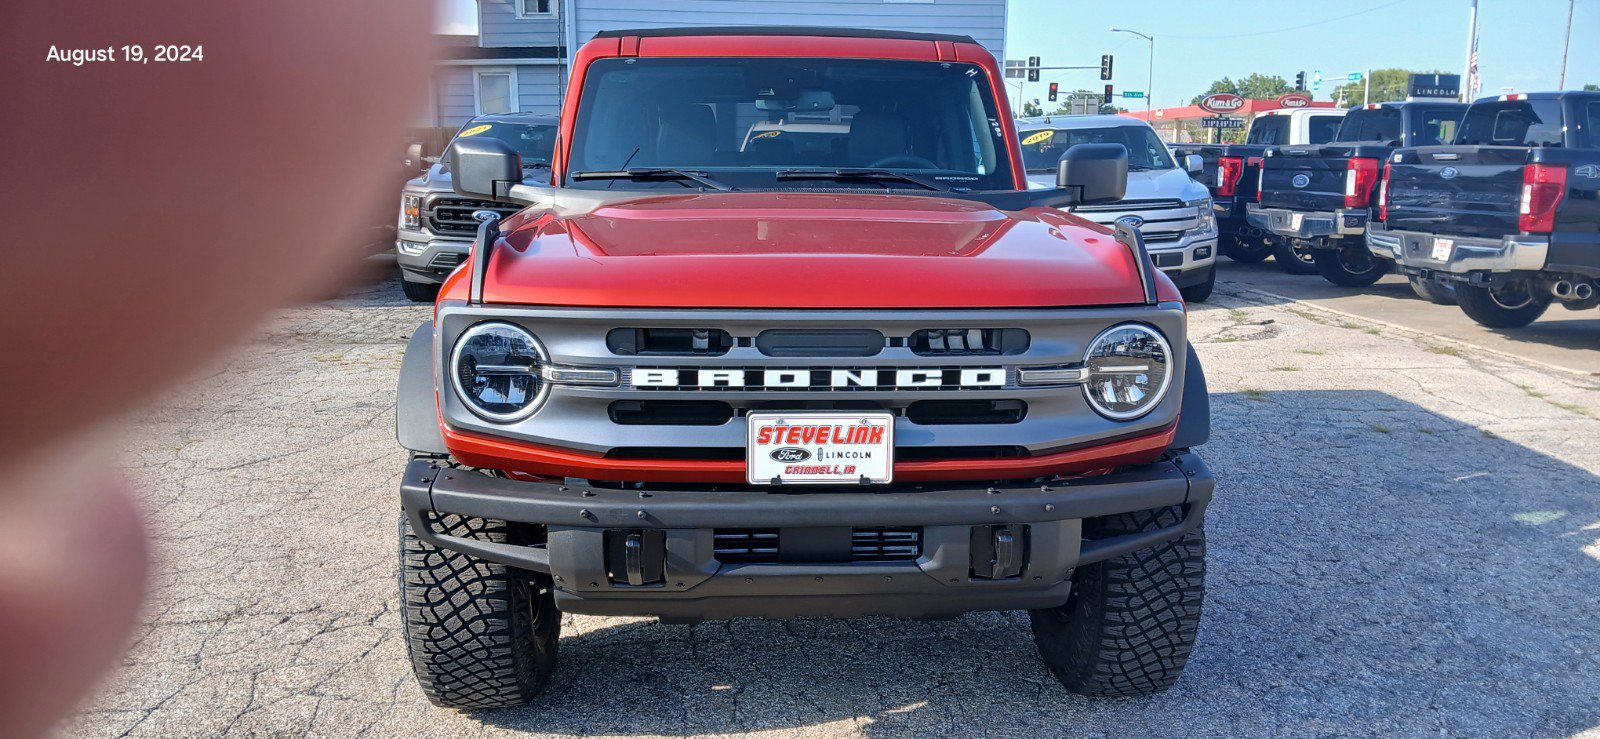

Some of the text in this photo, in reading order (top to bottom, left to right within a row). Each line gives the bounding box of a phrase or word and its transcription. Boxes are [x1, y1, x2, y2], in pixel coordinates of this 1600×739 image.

[1417, 88, 1456, 96] LINCOLN
[631, 368, 1006, 387] BRONCO
[757, 425, 886, 445] STEVE LINK
[776, 449, 805, 461] Ford
[826, 451, 872, 459] LINCOLN
